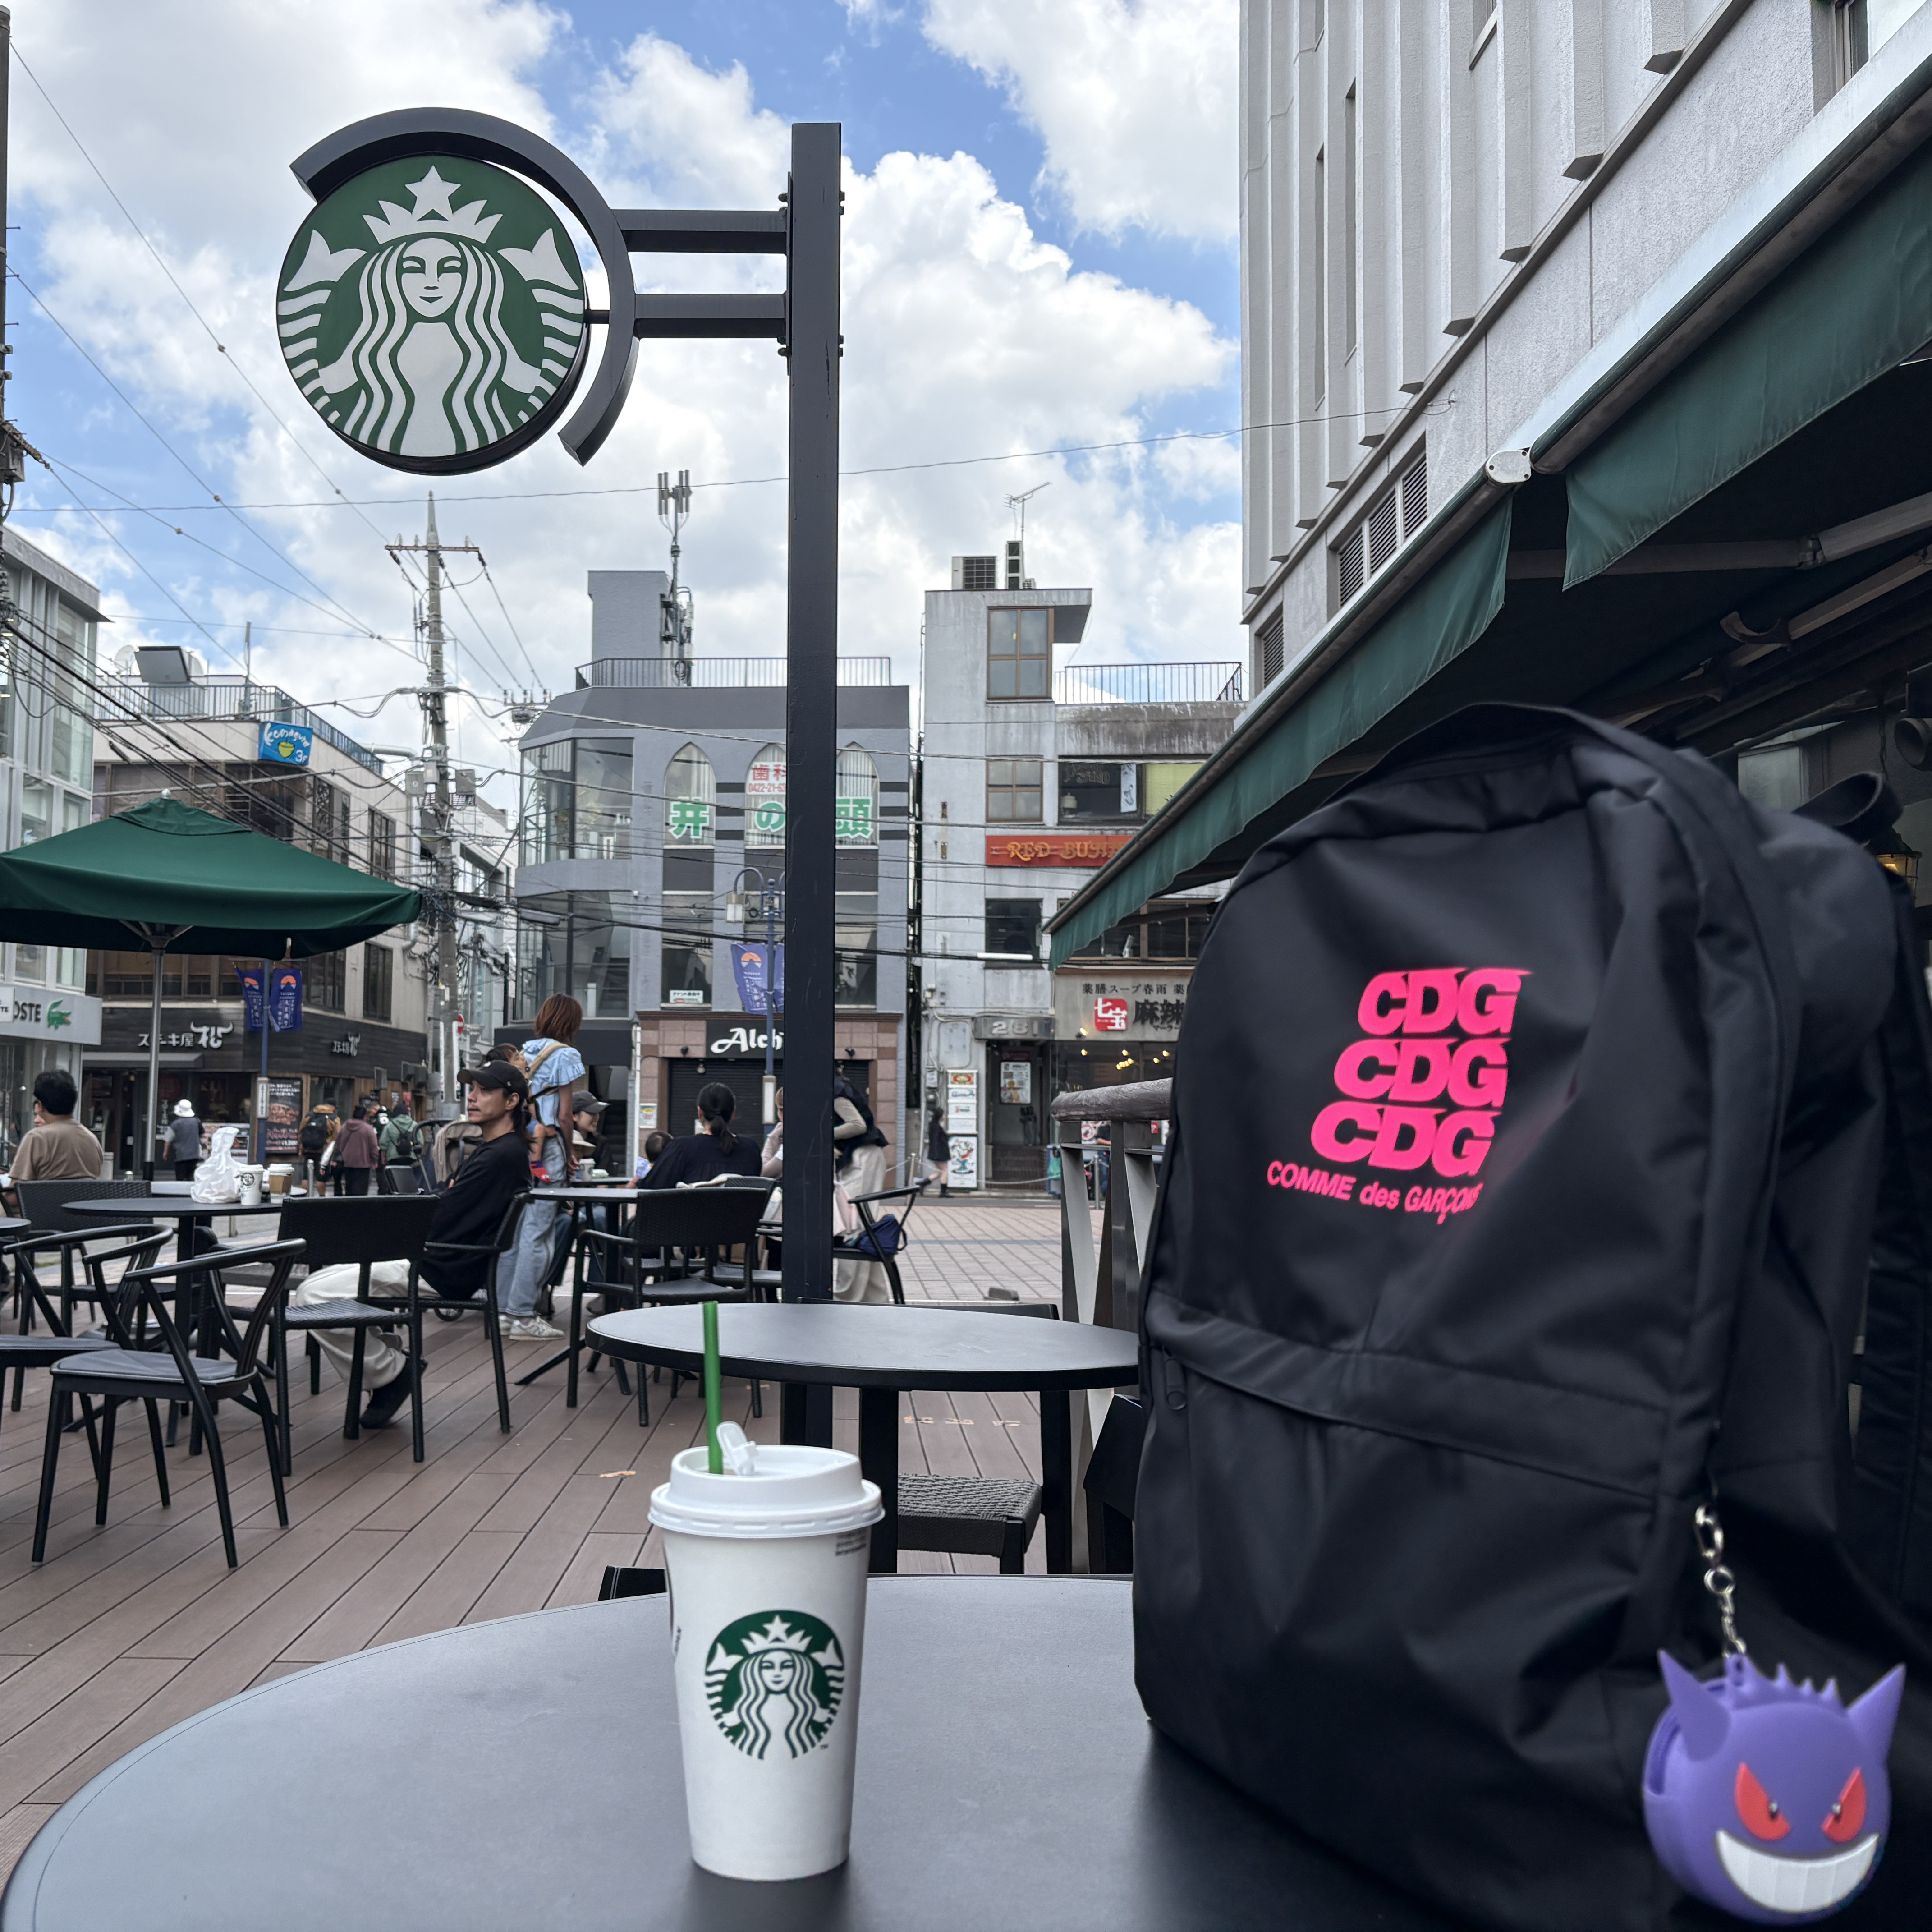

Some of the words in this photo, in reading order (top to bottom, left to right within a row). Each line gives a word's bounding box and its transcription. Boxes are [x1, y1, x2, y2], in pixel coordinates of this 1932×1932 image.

[1007, 841, 1051, 862] RED
[1083, 983, 1167, 994] 薬膳スープ春雨
[1358, 968, 1532, 1035] CDG
[711, 1027, 784, 1053] Alch
[1334, 1038, 1511, 1108] CDG
[1311, 1100, 1502, 1177] CDG
[1267, 1160, 1357, 1201] COMME
[1359, 1181, 1401, 1210] des
